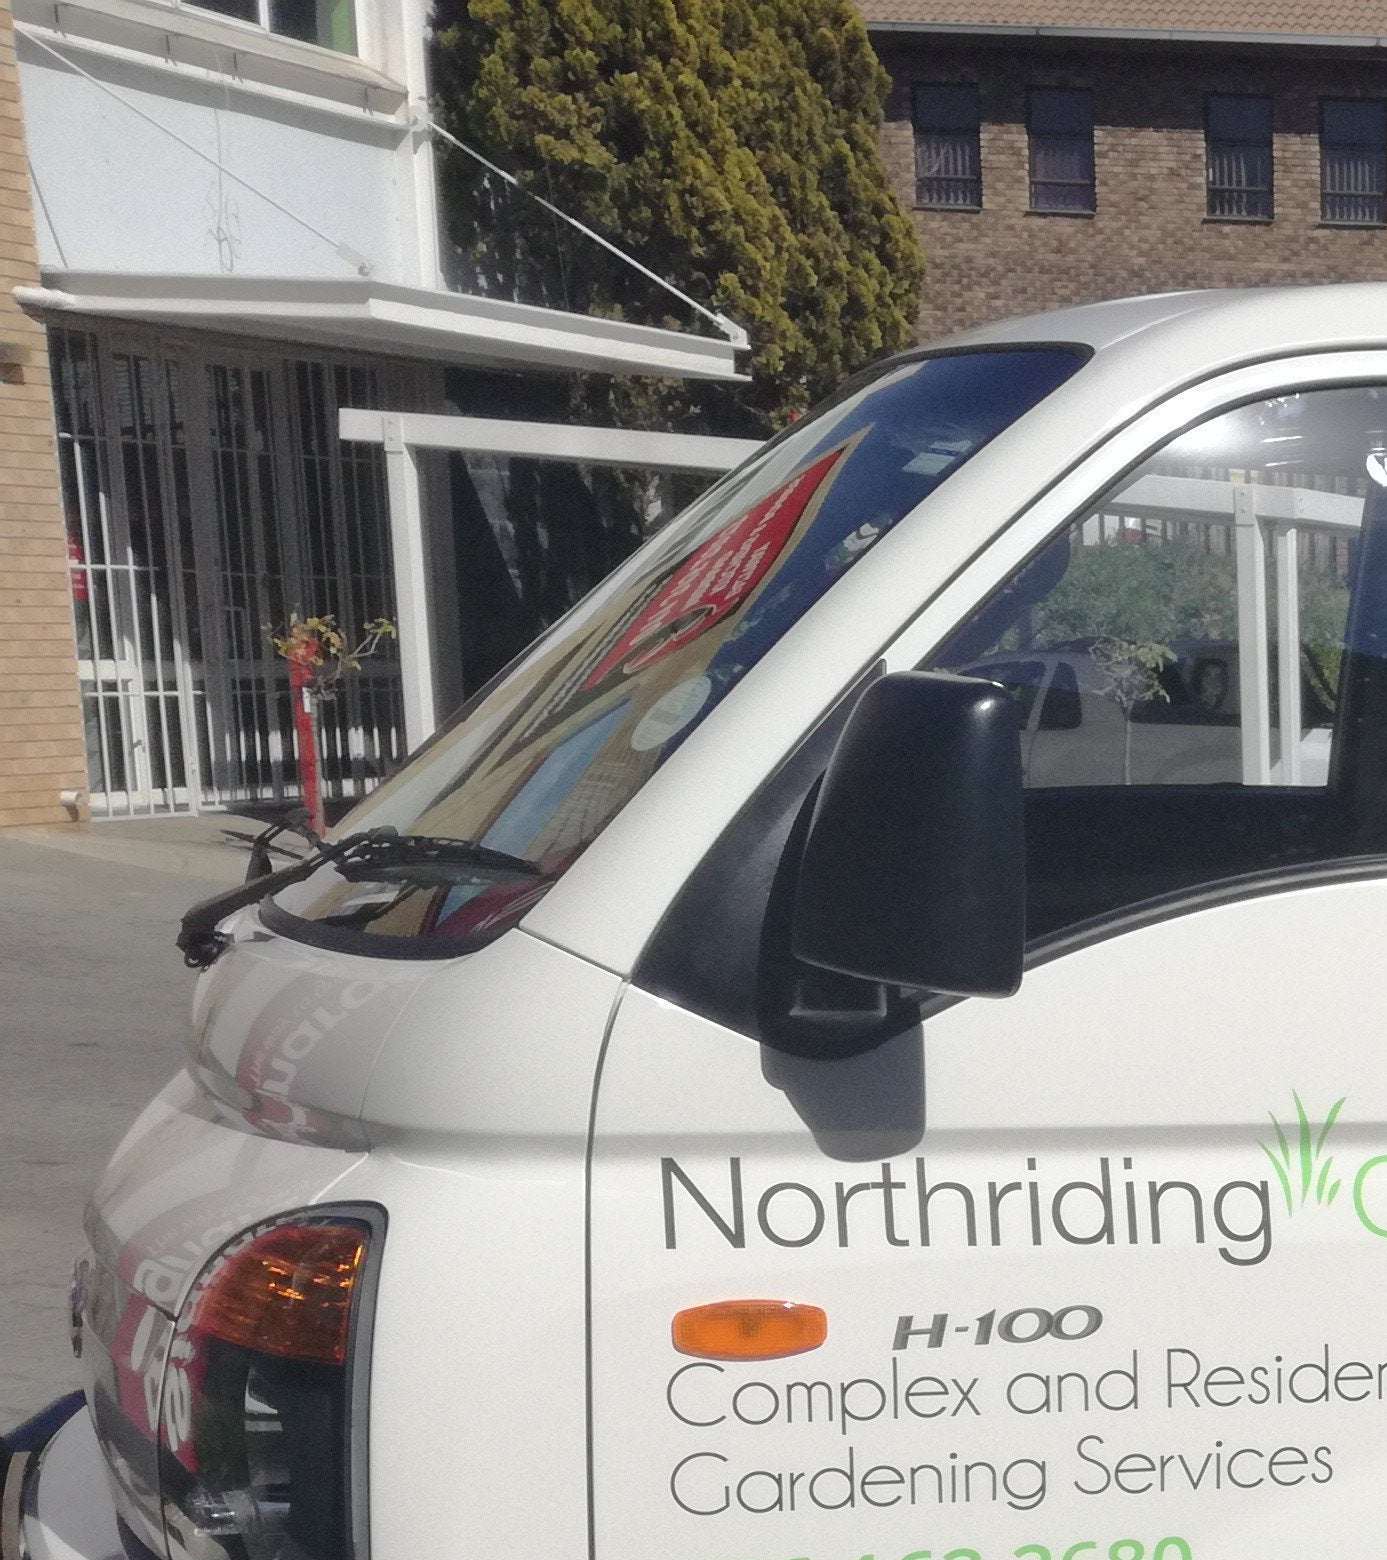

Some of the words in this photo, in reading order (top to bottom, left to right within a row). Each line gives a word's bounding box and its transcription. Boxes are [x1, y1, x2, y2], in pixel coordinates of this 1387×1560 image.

[660, 1156, 1272, 1267] Northriding
[892, 1304, 1103, 1351] H-100
[666, 1356, 981, 1435] Complex
[1006, 1349, 1139, 1414] and
[670, 1446, 1047, 1516] Gardening
[1073, 1434, 1334, 1495] Services
